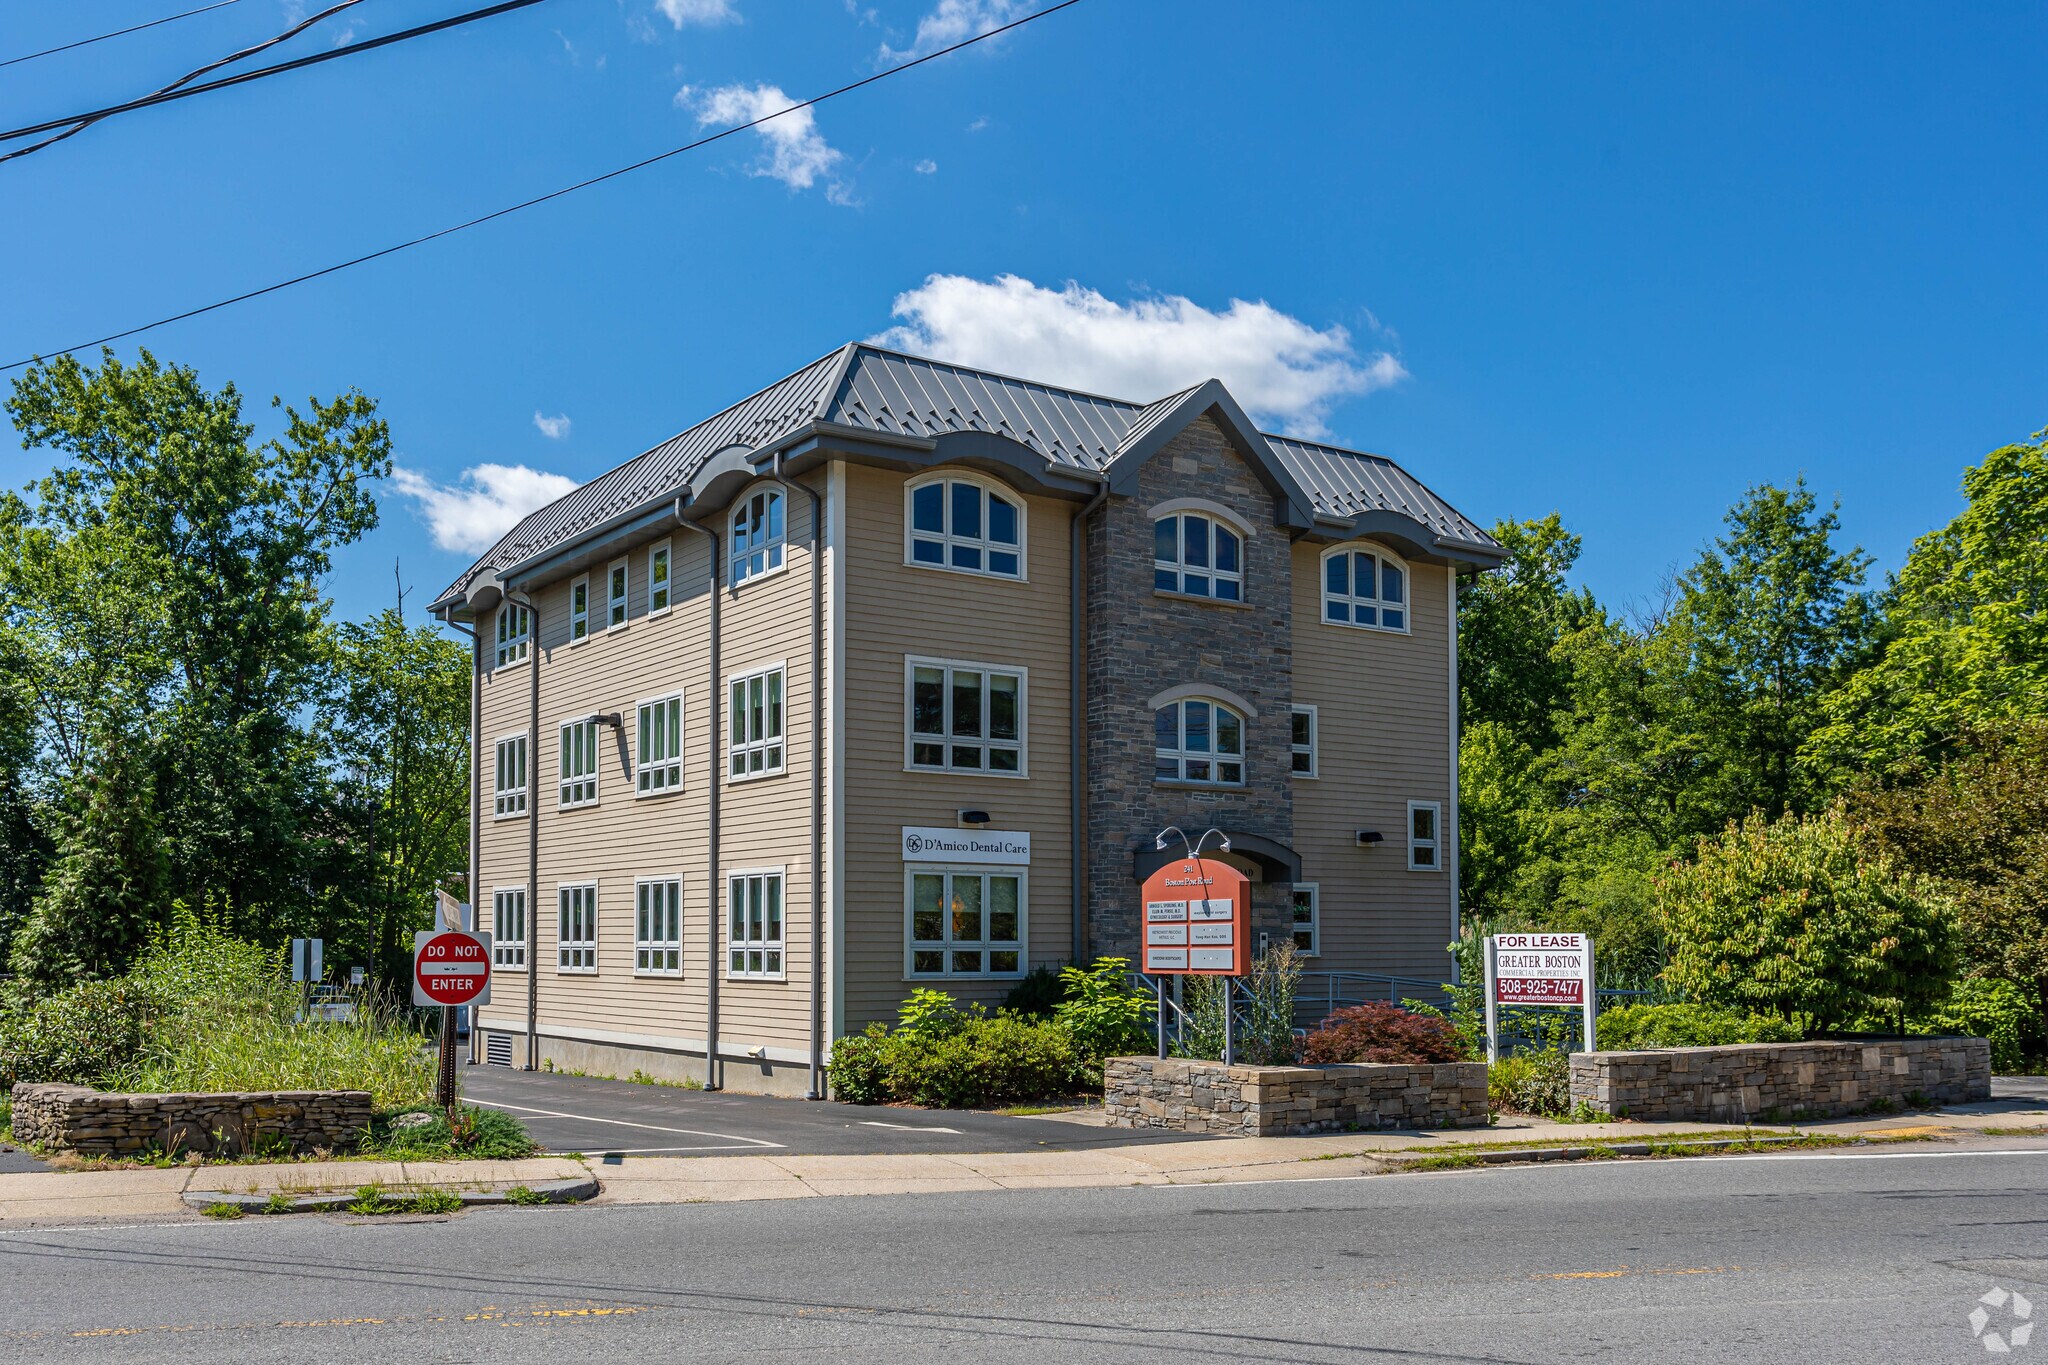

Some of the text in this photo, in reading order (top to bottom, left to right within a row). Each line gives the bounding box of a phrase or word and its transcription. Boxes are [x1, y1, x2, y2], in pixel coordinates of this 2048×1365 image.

[925, 839, 1028, 854] D'Amico Dental Care
[1184, 865, 1193, 873] 241
[1165, 876, 1213, 887] Boston Post Road
[1499, 936, 1580, 947] FOR LEASE
[427, 945, 480, 957] DO NOT
[1498, 955, 1581, 968] GREATER BOSTON
[1499, 969, 1535, 977] COMMERCIAL
[1537, 969, 1569, 977] PROPERTIES
[431, 979, 473, 990] ENTER
[1500, 979, 1580, 995] 508-925-7477
[1504, 993, 1577, 1002] www.greaterbostoncp.com
